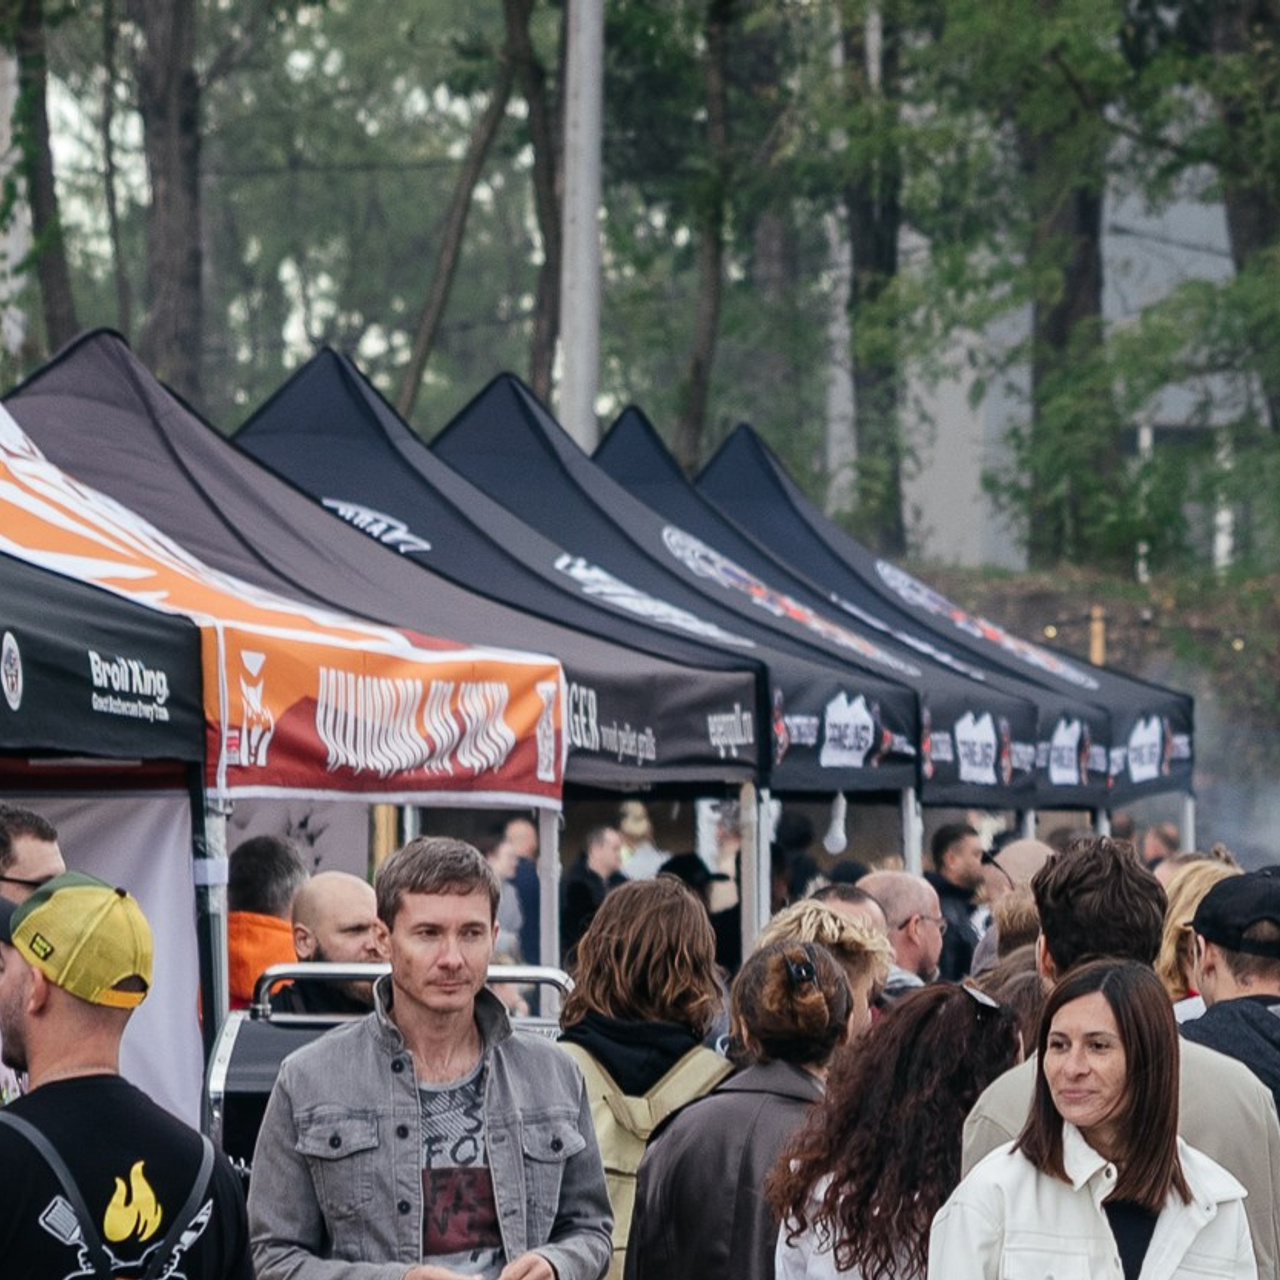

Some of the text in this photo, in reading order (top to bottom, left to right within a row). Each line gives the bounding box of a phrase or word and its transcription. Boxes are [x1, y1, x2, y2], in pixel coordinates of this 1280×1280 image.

[88, 650, 169, 705] Broil King
[568, 682, 600, 751] GER
